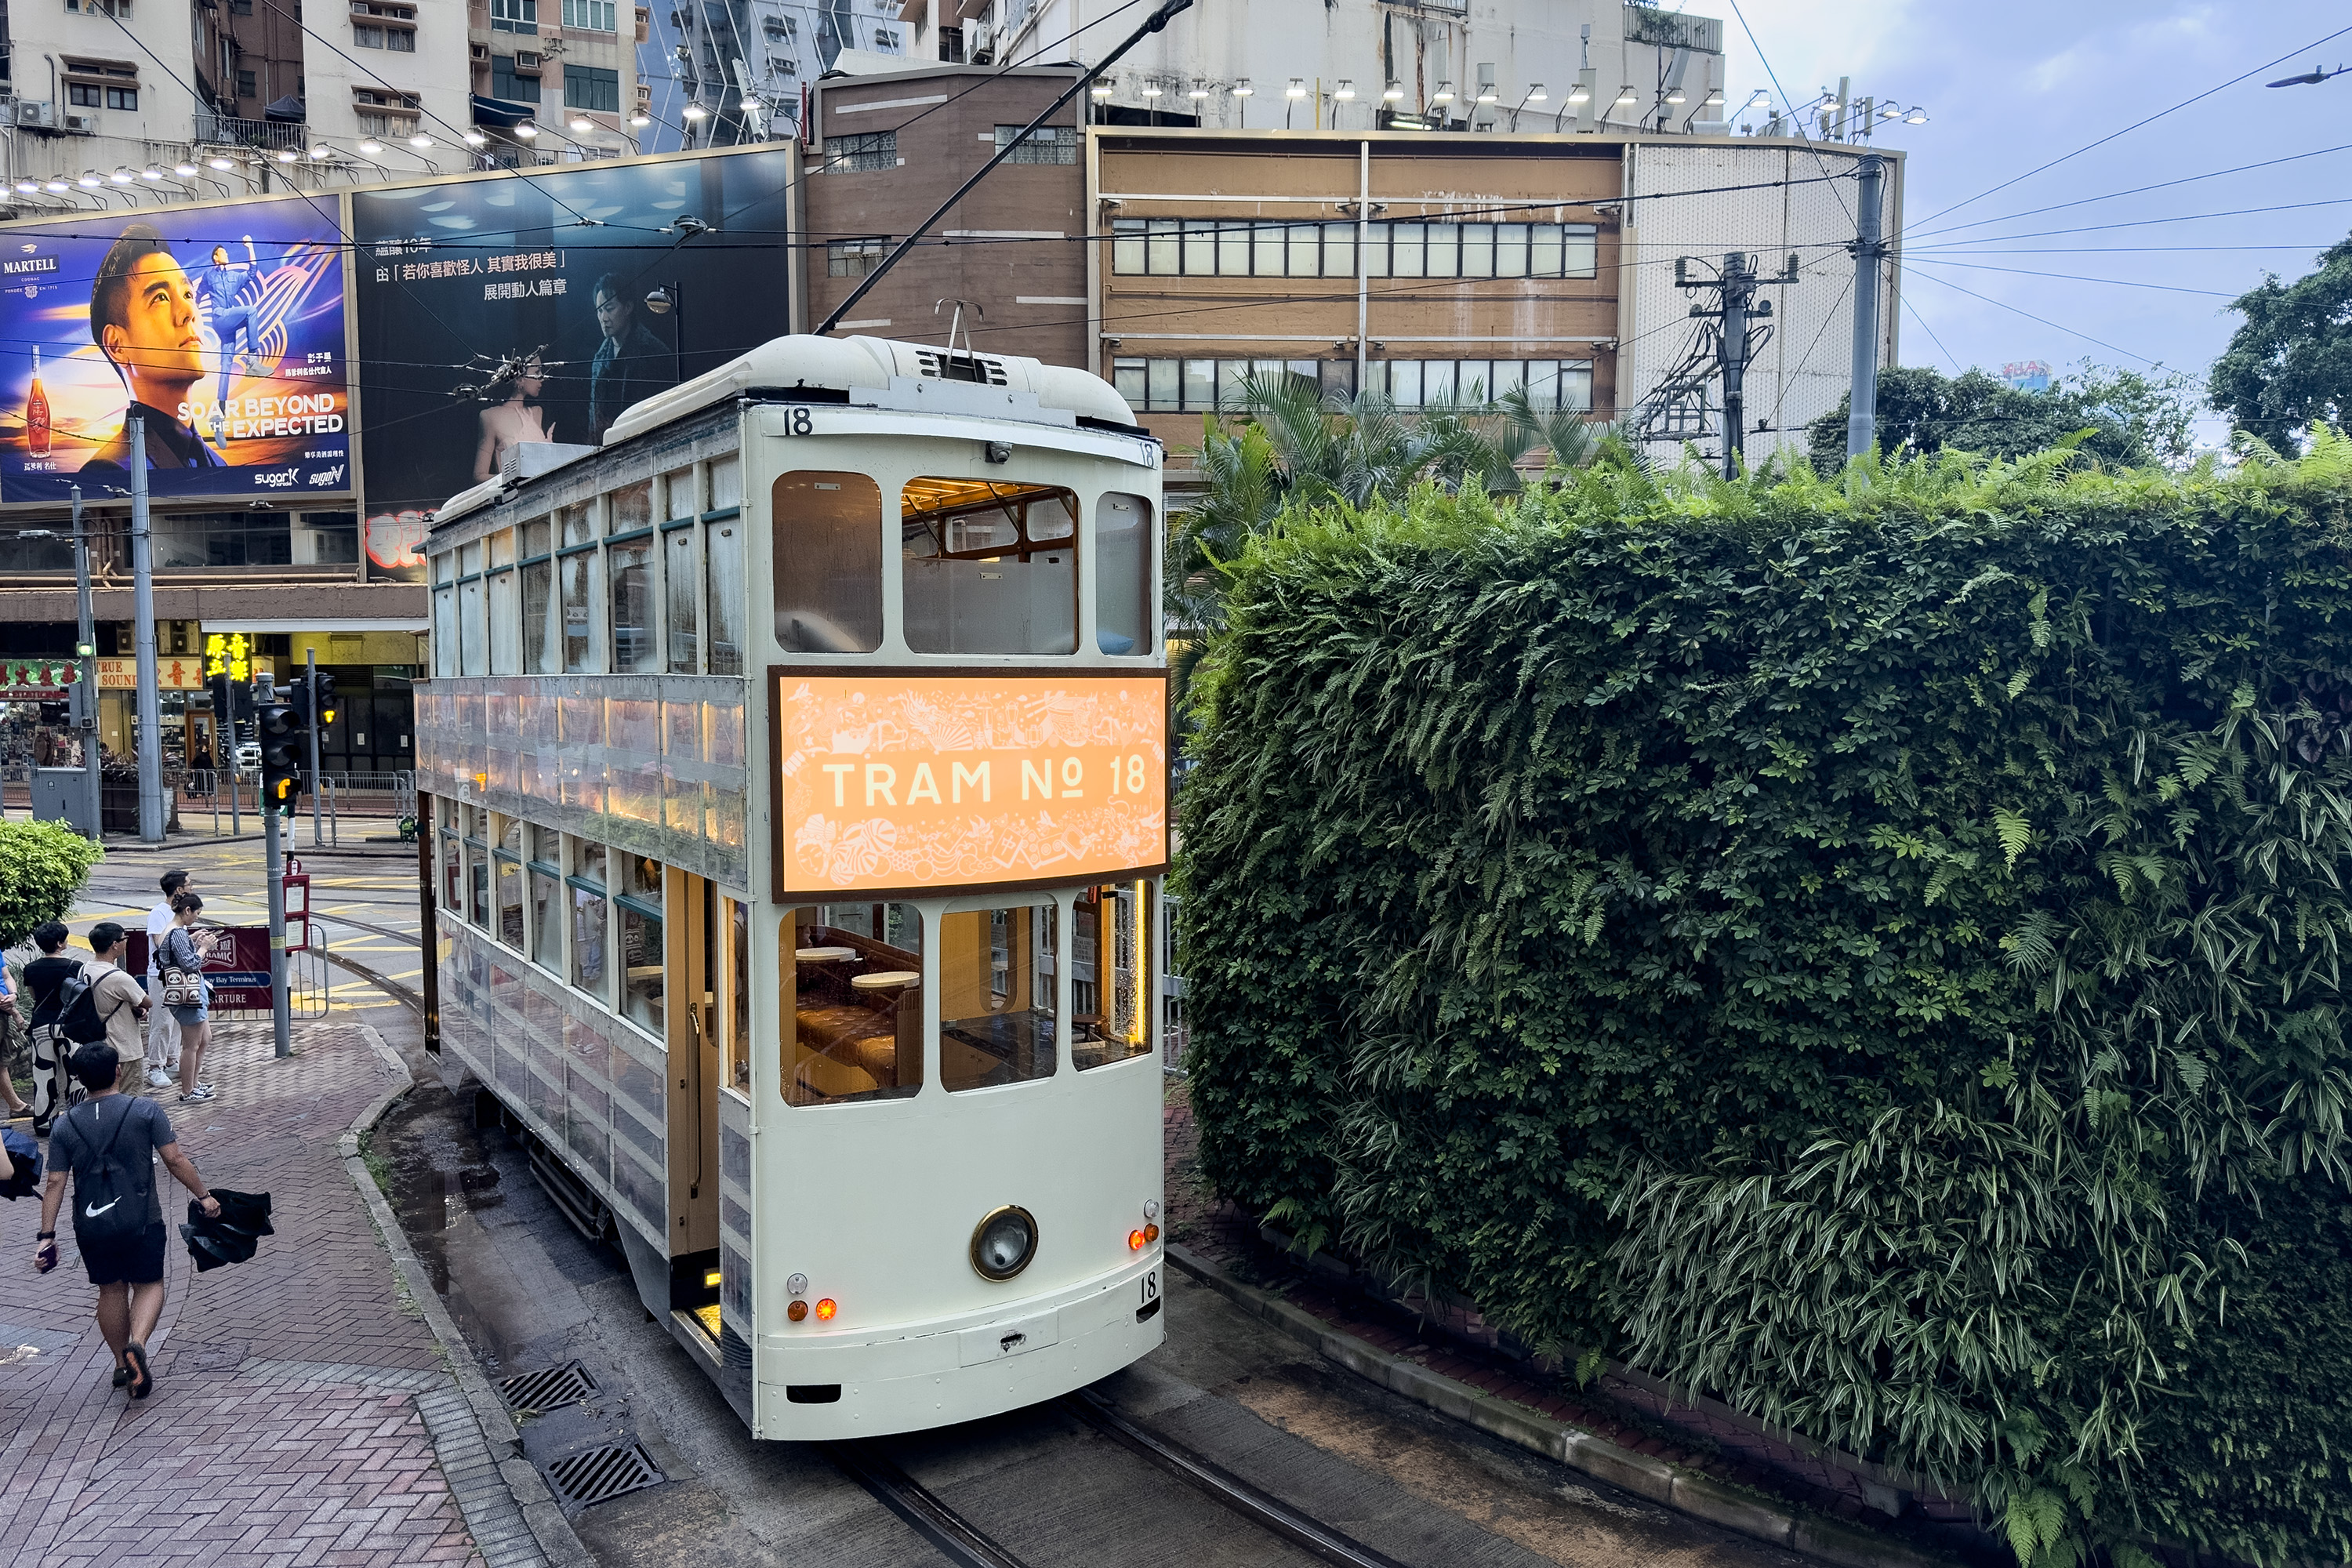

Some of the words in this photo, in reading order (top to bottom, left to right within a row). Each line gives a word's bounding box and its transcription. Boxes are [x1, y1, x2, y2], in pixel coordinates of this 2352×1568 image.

[4, 259, 56, 274] MARTELL
[484, 278, 568, 301] 展開動人篇章
[177, 399, 240, 421] SOAR
[245, 393, 335, 417] BEYOND
[208, 420, 230, 433] THE
[233, 414, 343, 438] EXPECTED
[784, 408, 813, 435] 18
[1139, 441, 1154, 468] 18
[96, 661, 122, 673] TRUE
[822, 760, 992, 808] TRAM
[1110, 753, 1146, 795] 18
[206, 952, 232, 963] RAMIC
[216, 976, 228, 985] Bay
[1142, 1271, 1156, 1305] 18
